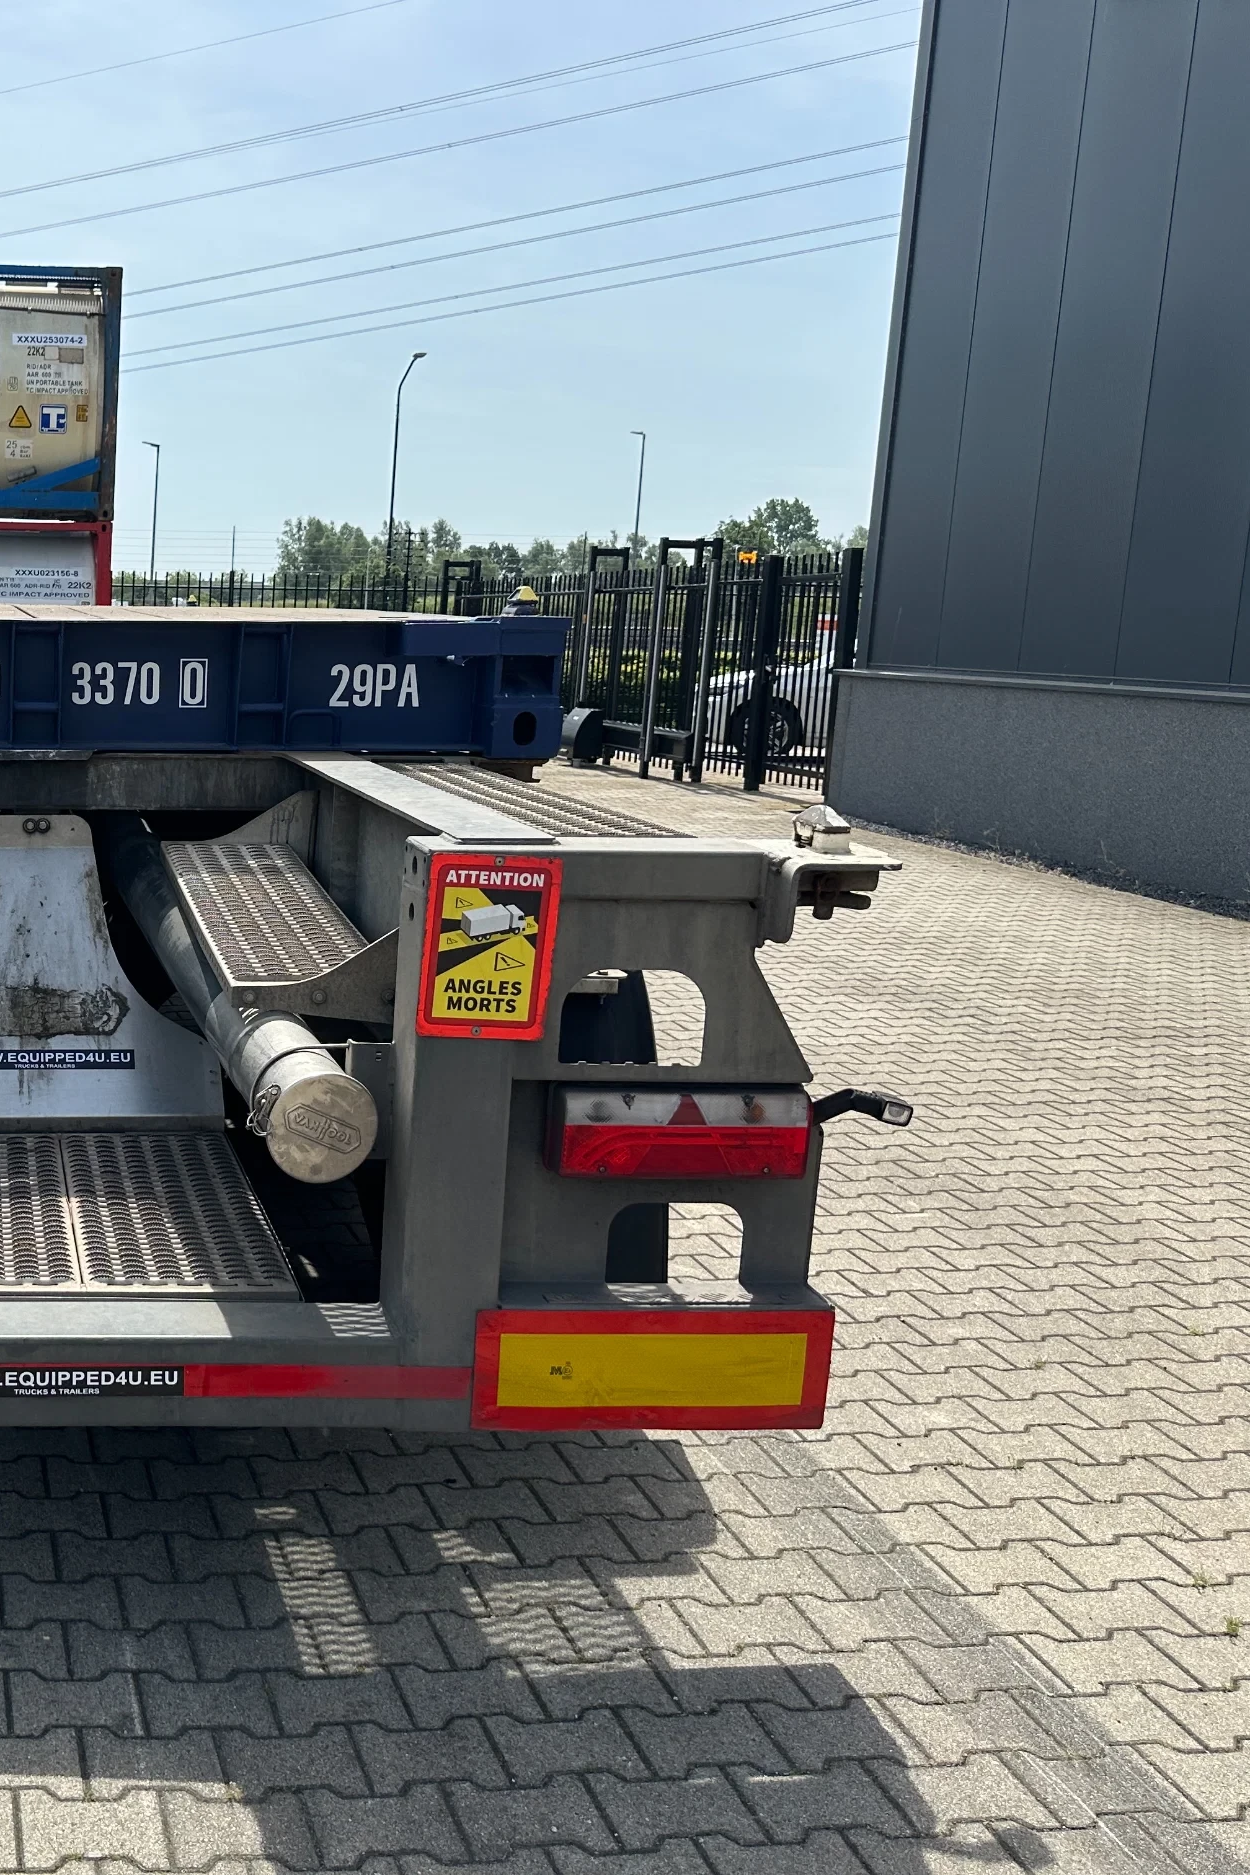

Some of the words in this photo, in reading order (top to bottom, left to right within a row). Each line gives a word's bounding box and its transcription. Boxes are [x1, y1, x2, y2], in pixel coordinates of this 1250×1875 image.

[16, 335, 84, 345] XXXU253074-2
[26, 346, 45, 356] 22K2
[35, 379, 66, 387] PORTABLE
[67, 380, 83, 388] TANK
[6, 440, 18, 449] 25
[9, 449, 16, 458] 4
[14, 569, 79, 577] XXXU023156-8
[67, 581, 92, 590] 22K2
[71, 661, 160, 705] 3370
[328, 662, 420, 708] 29PA
[445, 869, 545, 887] ATTENTION
[443, 978, 522, 996] ANGLES
[446, 996, 517, 1014] MORTS
[13, 1388, 49, 1396] TRUCKS
[58, 1387, 100, 1396] TRAILERS
